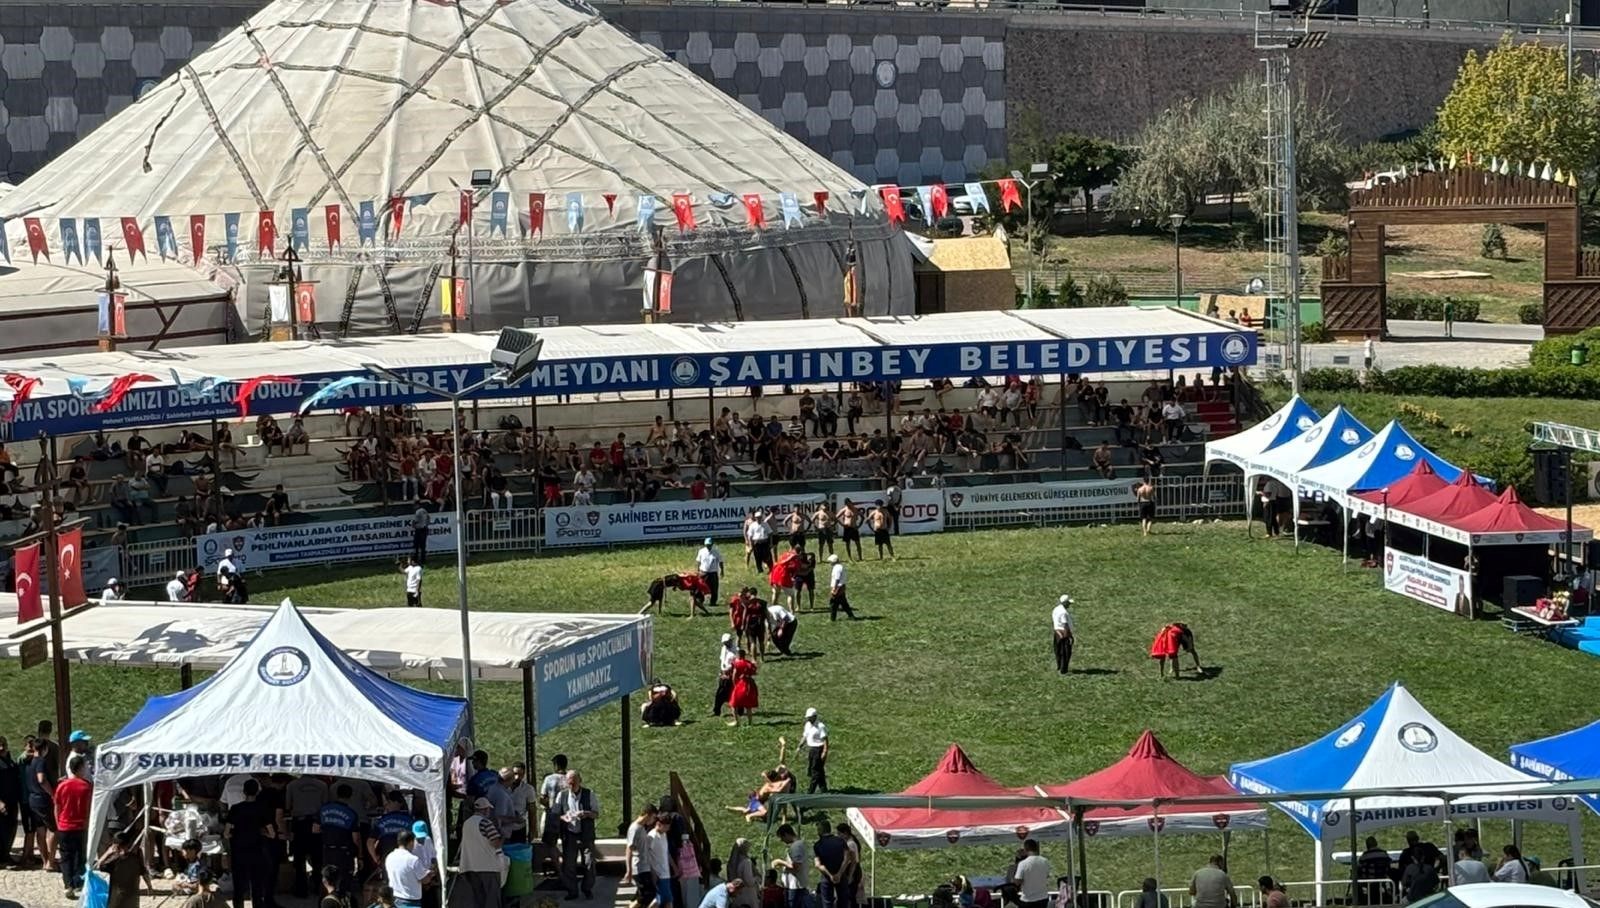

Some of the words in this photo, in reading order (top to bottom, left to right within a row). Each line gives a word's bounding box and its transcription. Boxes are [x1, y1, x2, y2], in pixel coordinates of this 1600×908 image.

[531, 359, 659, 388] MEYDANI
[14, 401, 44, 422] ATA
[311, 526, 333, 536] ABA
[404, 516, 449, 528] KLAN
[608, 510, 662, 525] ŞAHİNBEY
[665, 510, 679, 521] ER
[682, 507, 746, 520] MEYDANINA
[410, 526, 452, 537] DERİM
[544, 652, 575, 682] SPORUN
[567, 664, 612, 698] YANINDAYIZ
[138, 750, 254, 769] ŞAHİNBEY
[263, 751, 395, 769] BELEDİYESİ
[1449, 799, 1543, 815] BELEDİYESİ
